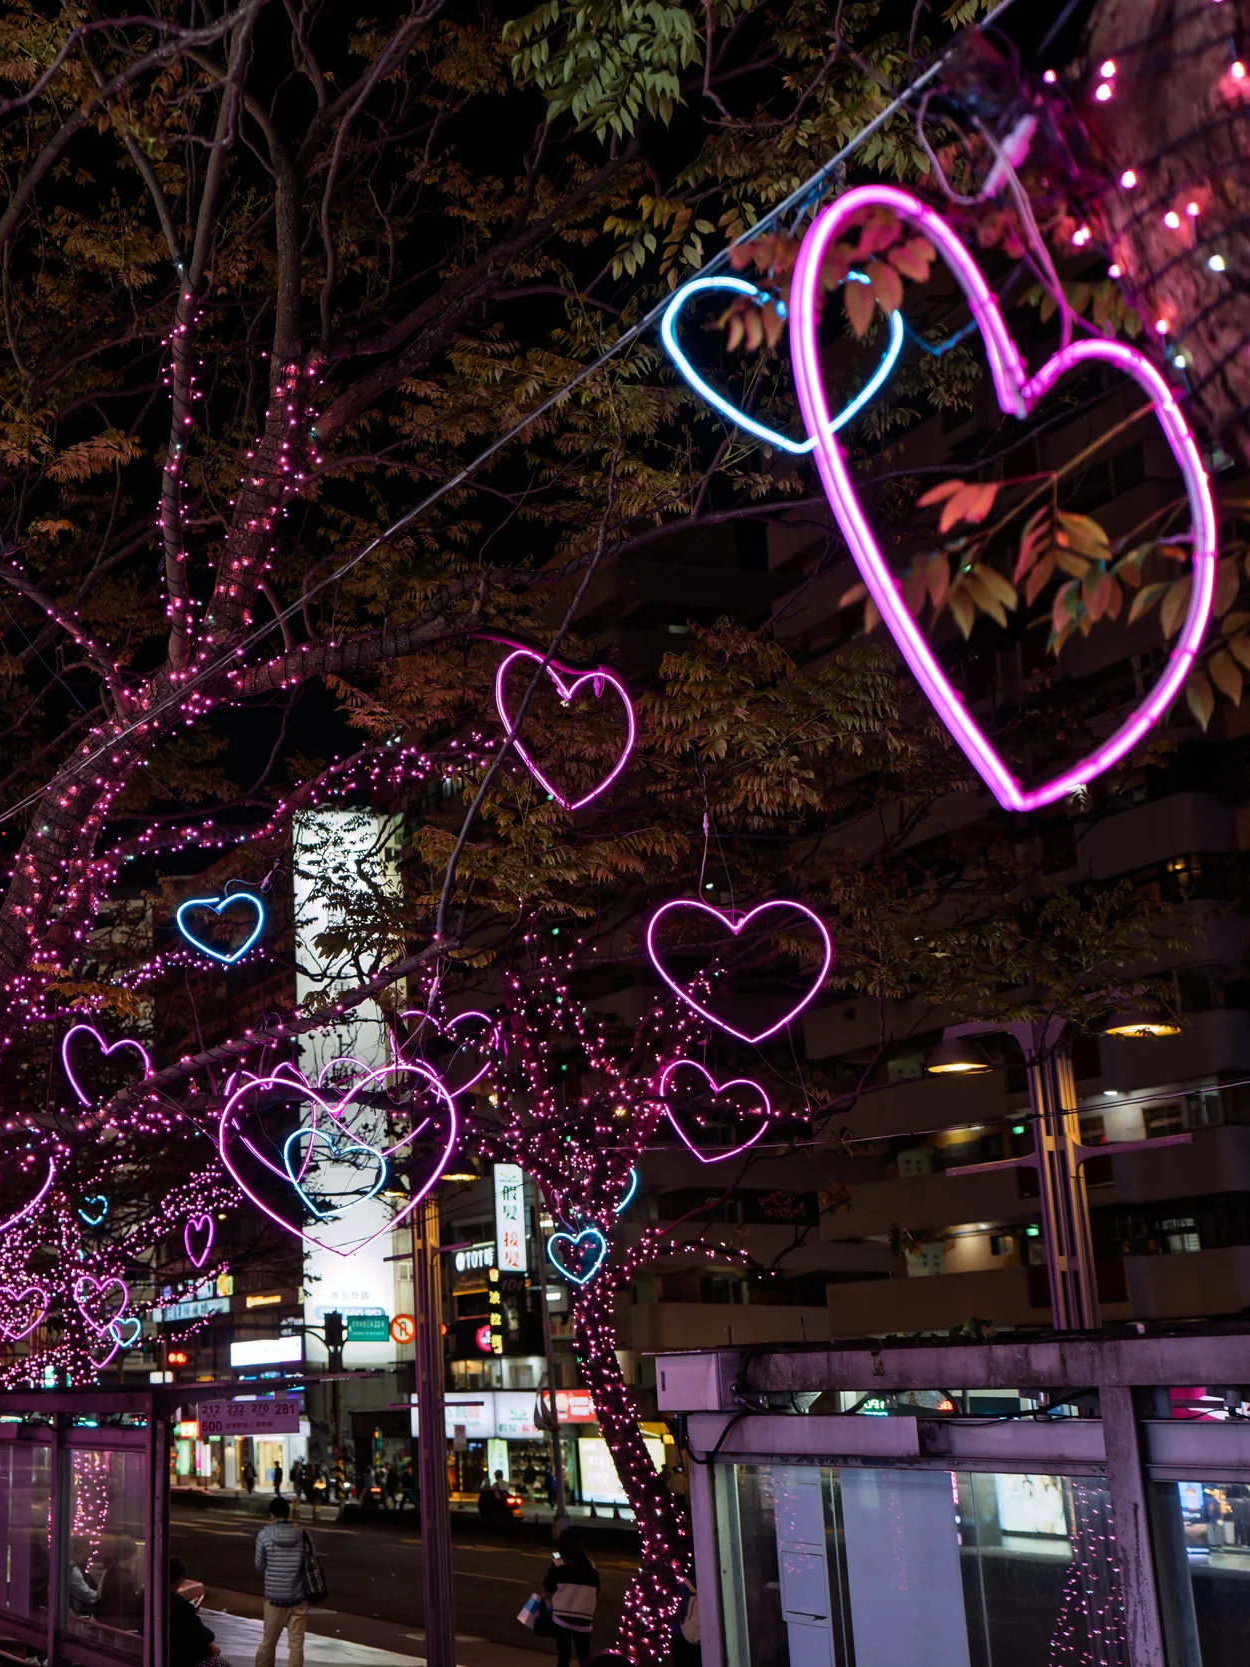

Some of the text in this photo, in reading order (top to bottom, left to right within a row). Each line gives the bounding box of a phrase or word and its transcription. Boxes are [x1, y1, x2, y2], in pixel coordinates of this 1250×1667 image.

[202, 1405, 221, 1414] 212
[227, 1404, 245, 1414] 232
[251, 1403, 270, 1413] 270
[275, 1403, 295, 1415] 281
[202, 1421, 223, 1432] 600
